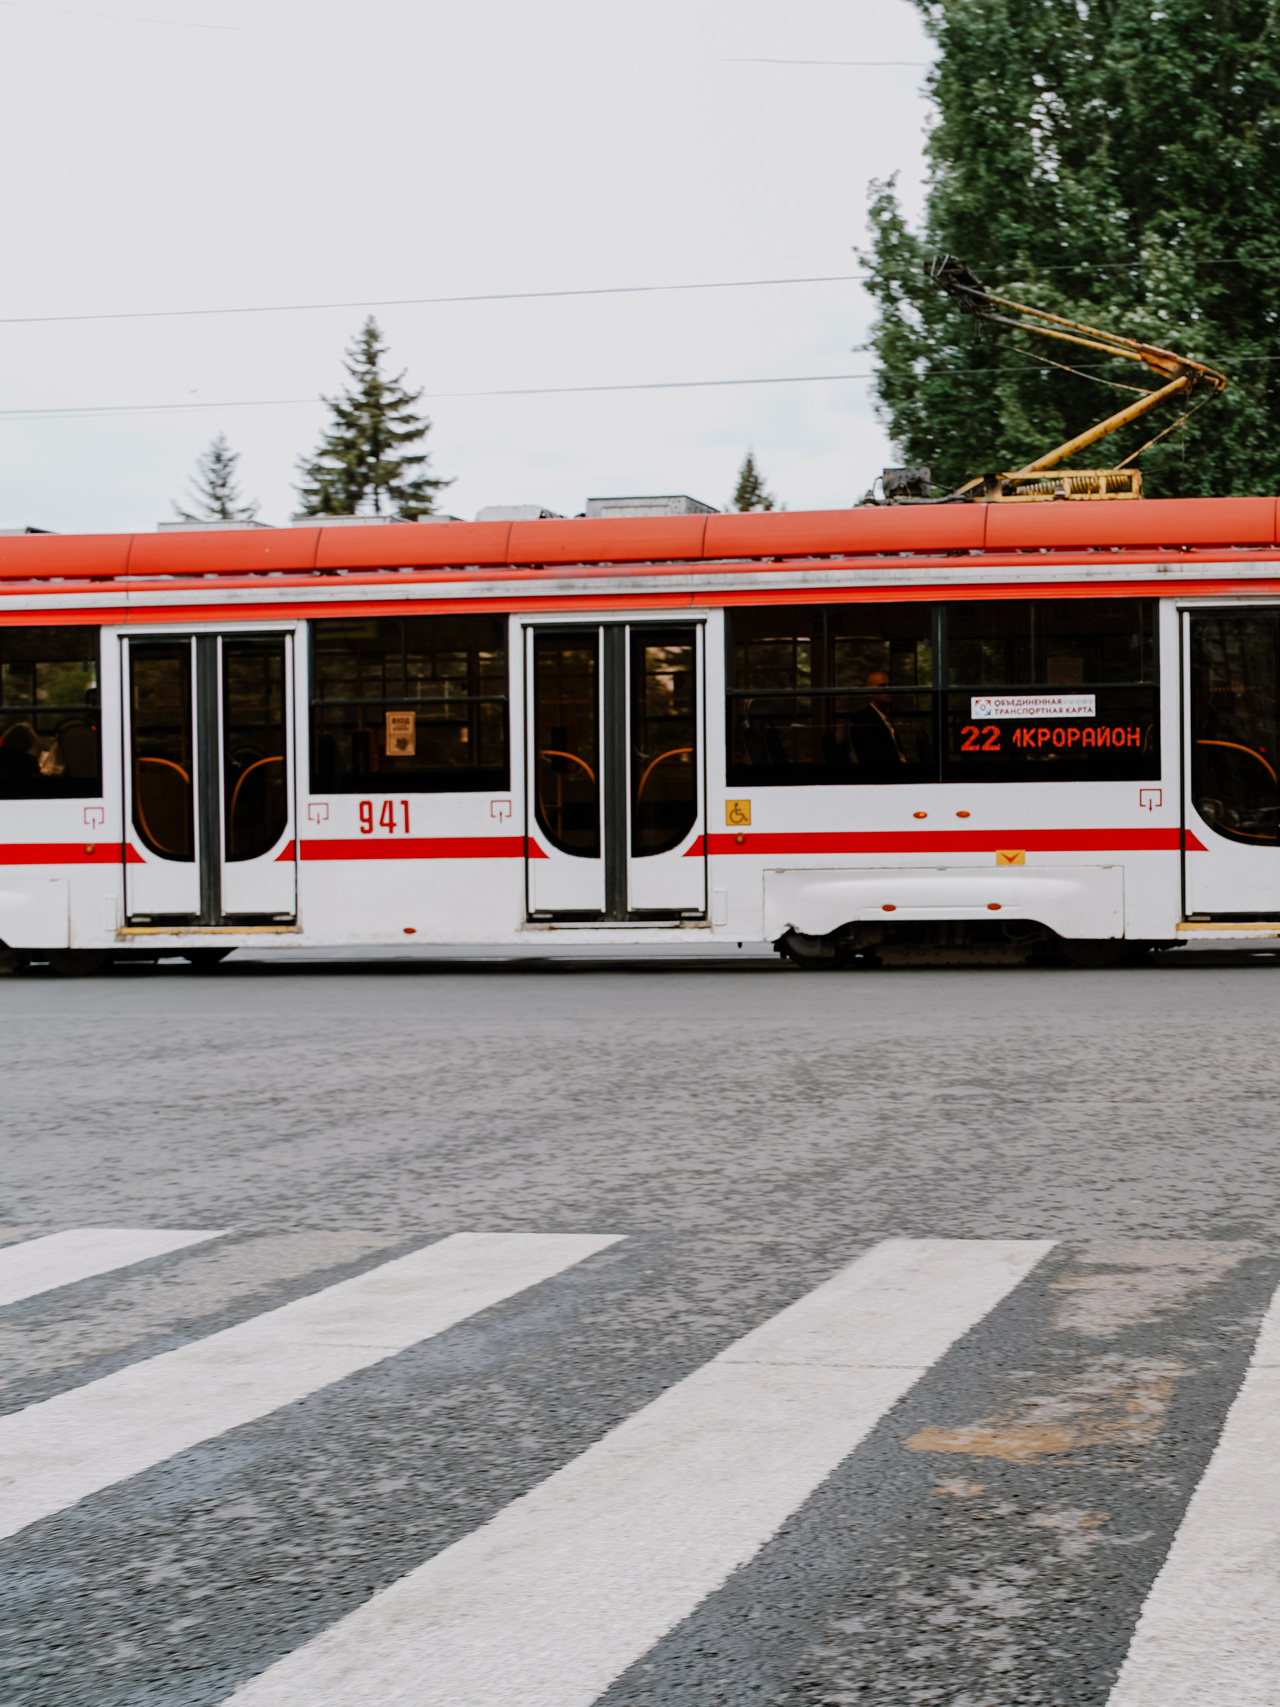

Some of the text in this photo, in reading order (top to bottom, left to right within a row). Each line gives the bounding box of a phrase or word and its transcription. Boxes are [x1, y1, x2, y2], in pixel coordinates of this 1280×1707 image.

[994, 698, 1062, 706] ОБЪЕДИНЕННАЯ
[994, 707, 1063, 715] ТРАНСПОРТНАЯ
[960, 725, 1000, 751] 22
[359, 800, 410, 834] 941
